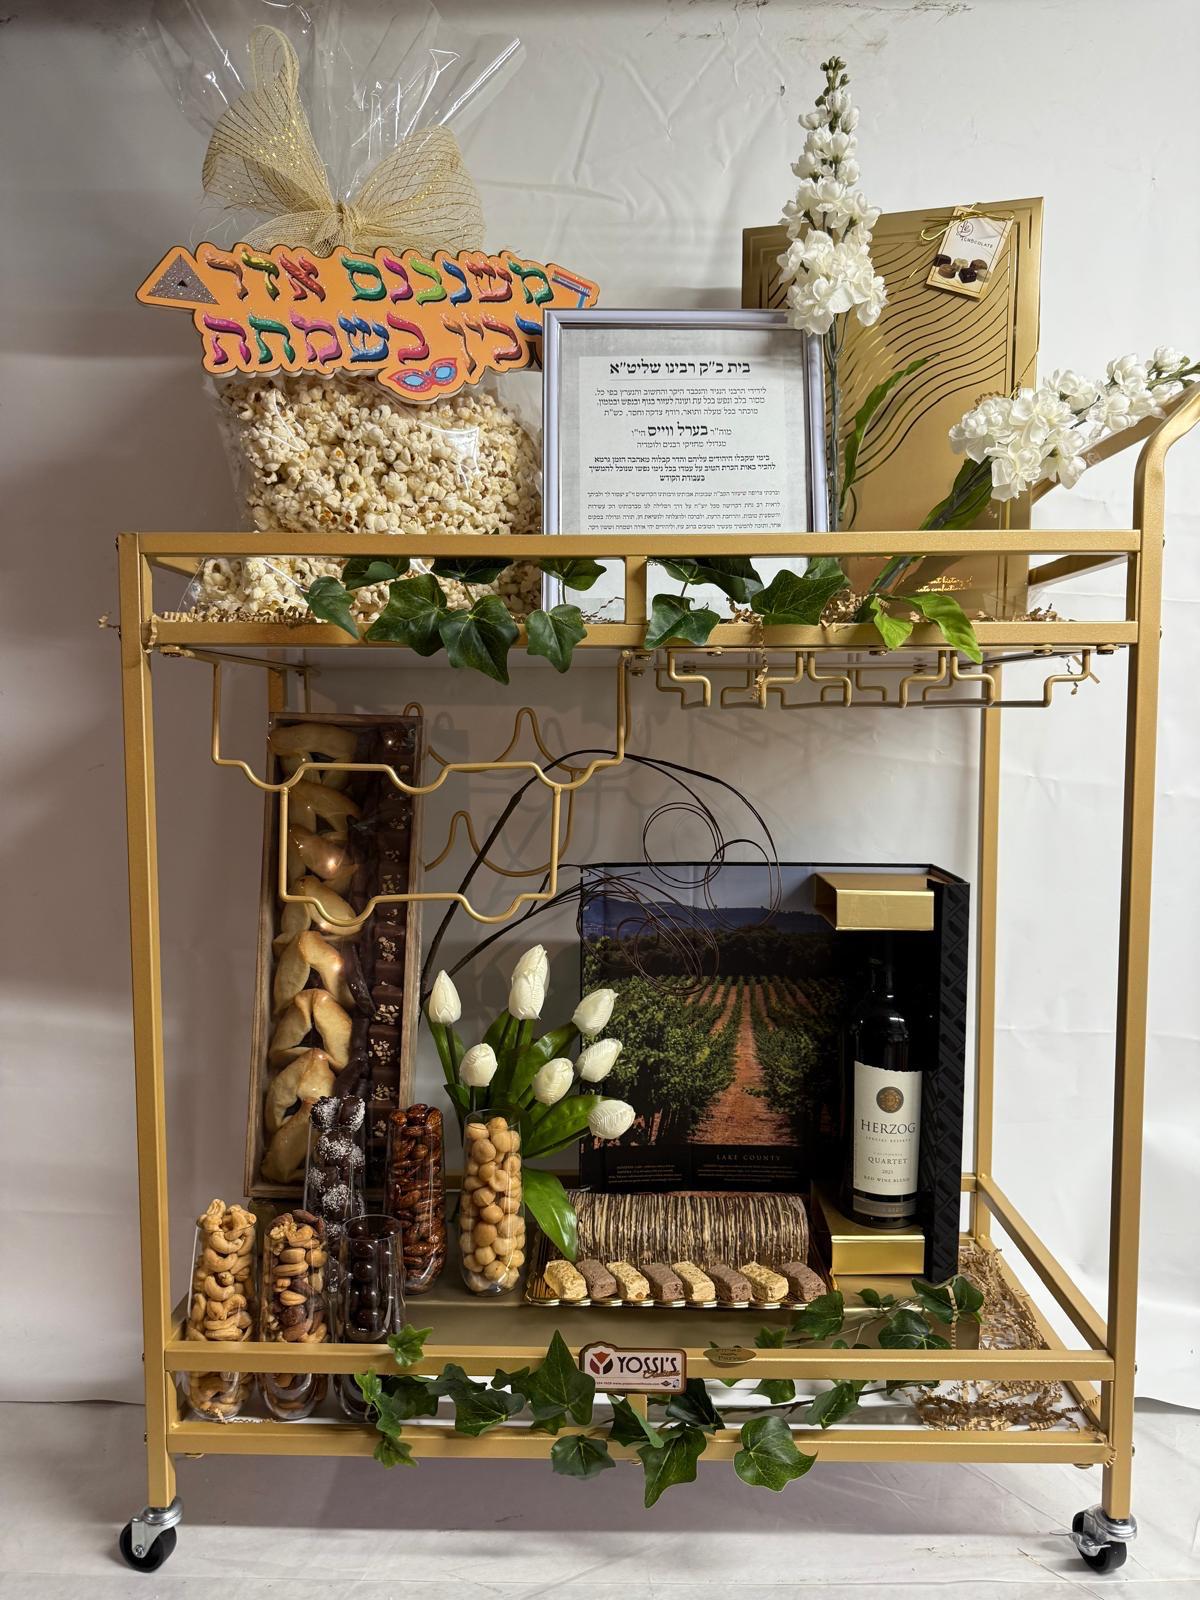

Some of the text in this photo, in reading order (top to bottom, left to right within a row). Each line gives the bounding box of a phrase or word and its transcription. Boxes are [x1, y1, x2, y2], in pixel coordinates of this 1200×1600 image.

[204, 248, 553, 306] משנכנס אדר
[203, 307, 430, 365] בשמחה
[610, 358, 662, 374] שליט"א
[665, 362, 696, 374] רבינו
[727, 362, 750, 374] בית
[648, 426, 674, 436] ווייס
[677, 420, 708, 436] בערל
[860, 1119, 916, 1135] HERZOG
[867, 1156, 908, 1165] QUARTET
[617, 1356, 677, 1373] YOSSI'S
